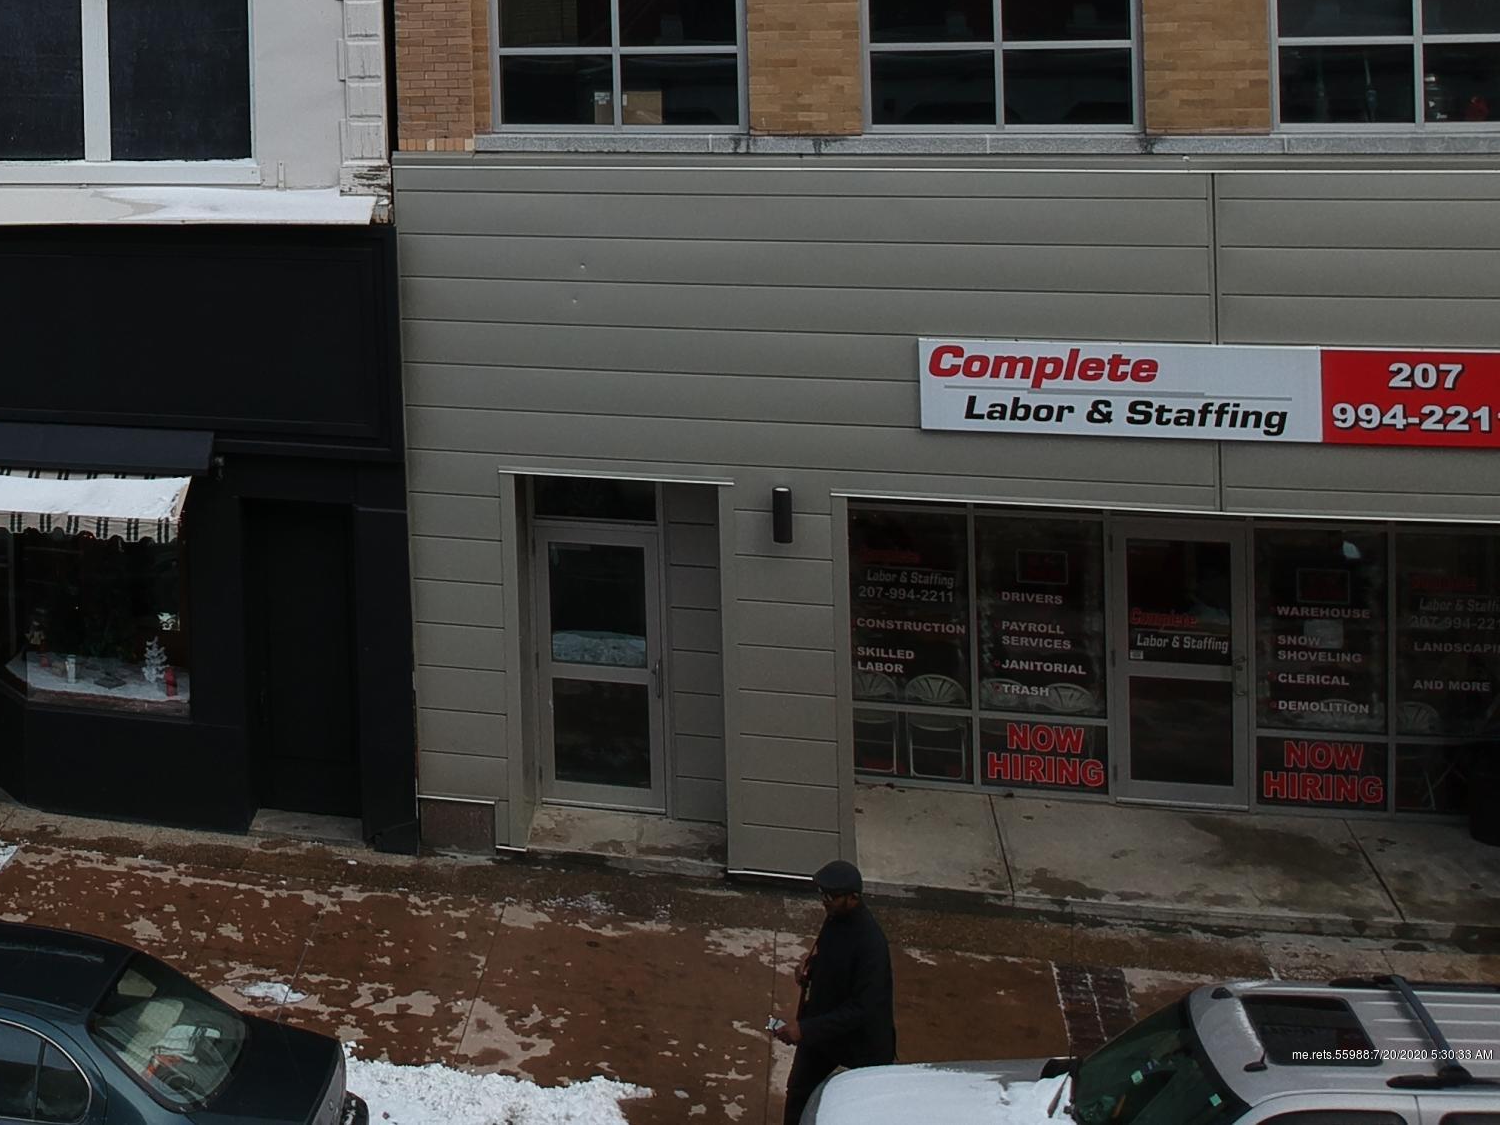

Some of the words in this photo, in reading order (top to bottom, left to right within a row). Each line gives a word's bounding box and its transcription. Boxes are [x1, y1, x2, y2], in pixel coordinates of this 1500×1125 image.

[928, 344, 1159, 389] Complete
[1388, 362, 1464, 390] 207
[964, 395, 1074, 423] Labor
[1086, 399, 1113, 425] &
[1126, 400, 1288, 436] Staffing
[1332, 403, 1500, 432] 994-221
[867, 569, 898, 583] Labor
[899, 571, 908, 583] &
[910, 572, 954, 589] Staffing
[858, 585, 954, 603] 207-994-2211
[1001, 592, 1063, 605] DRIVERS
[1276, 606, 1371, 619] WAREHOUSE
[856, 618, 966, 635] CONSTRUCTION
[1002, 620, 1065, 635] PAYROLL
[1002, 635, 1072, 650] SERVICES
[1136, 633, 1169, 648] Labor
[1171, 635, 1180, 648] &
[1183, 636, 1229, 654] Staffing
[1277, 635, 1321, 647] SNOW
[1413, 641, 1500, 654] LANDSCAPI
[856, 646, 915, 660] SKILLED
[1277, 650, 1363, 664] SHOVELING
[857, 660, 904, 674] LABOR
[1002, 660, 1087, 675] JANITORIAL
[1278, 673, 1350, 686] CLERICAL
[1412, 679, 1444, 691] AND
[1449, 680, 1491, 692] MORE
[1002, 683, 1049, 697] TRASH
[1278, 700, 1370, 715] DEMOLITION
[1006, 722, 1085, 754] NOW
[1283, 740, 1365, 771] NOW
[987, 751, 1105, 787] HIRING
[1263, 771, 1384, 804] HIRING
